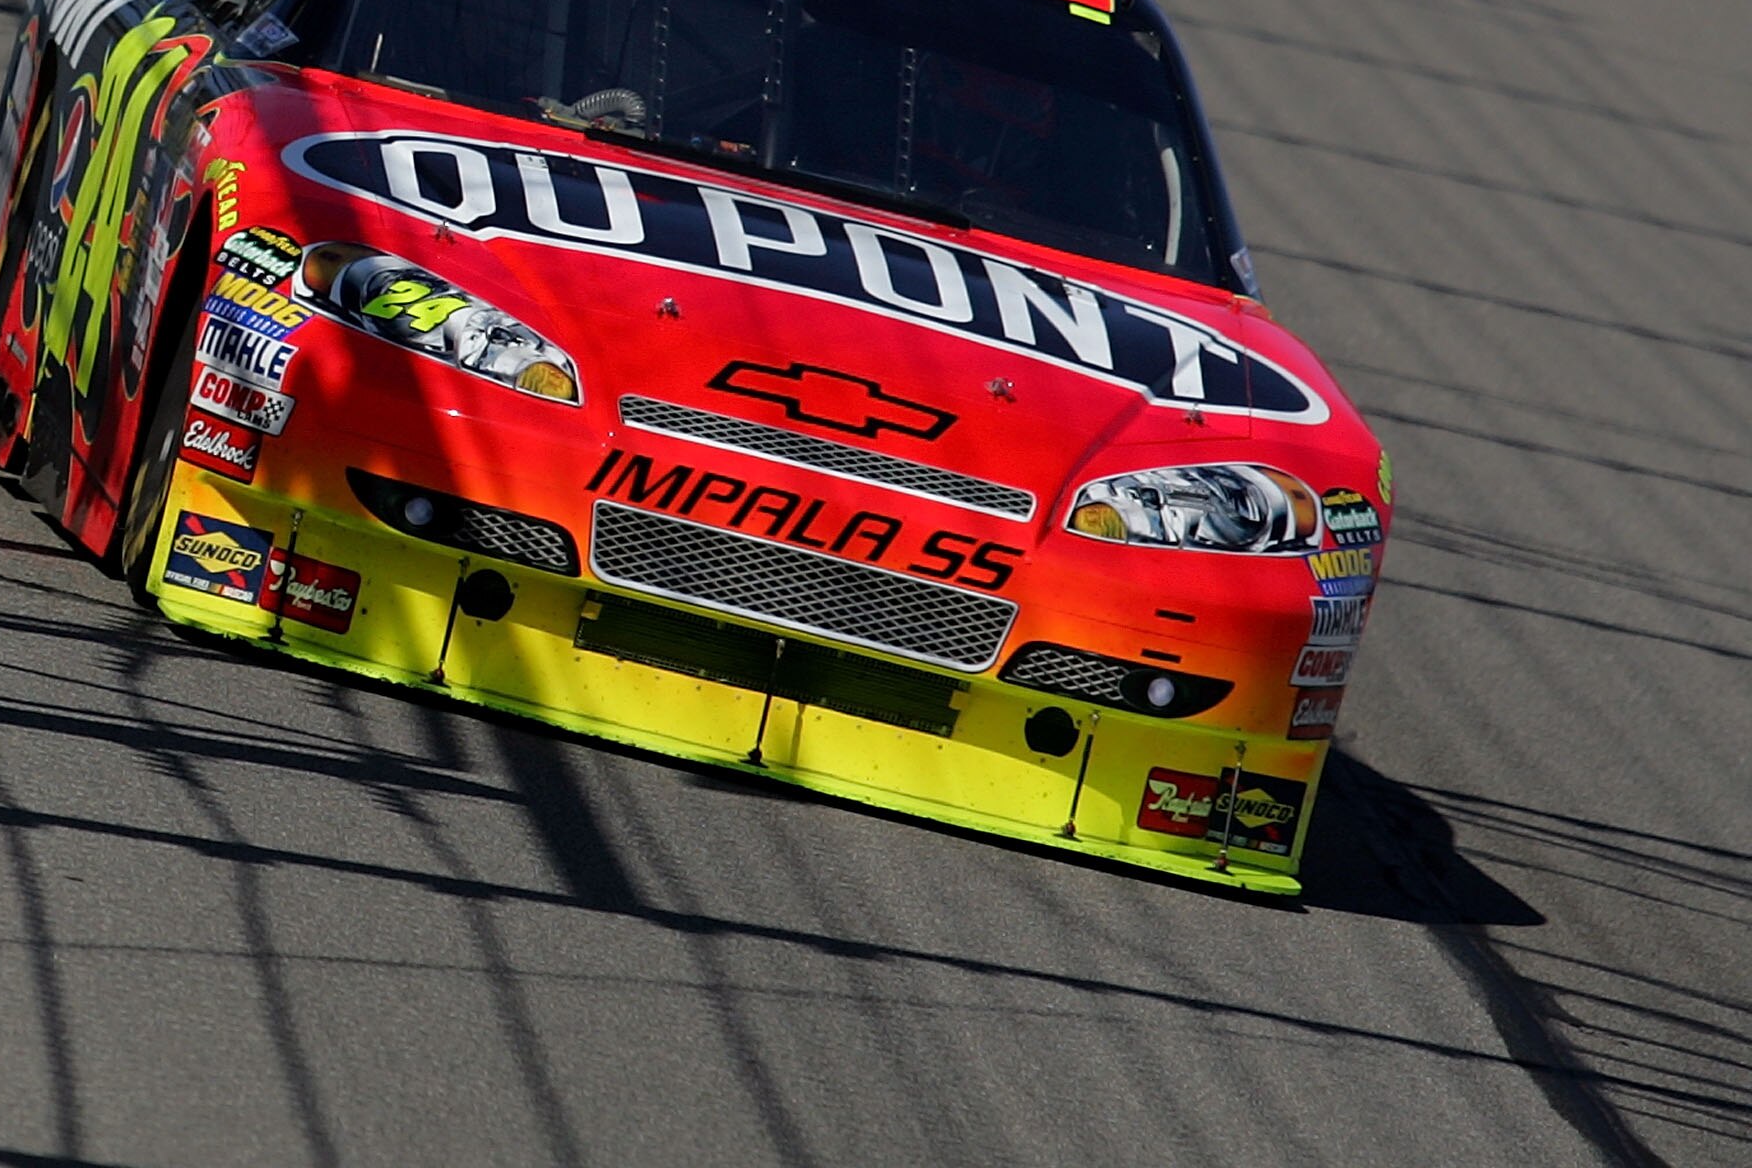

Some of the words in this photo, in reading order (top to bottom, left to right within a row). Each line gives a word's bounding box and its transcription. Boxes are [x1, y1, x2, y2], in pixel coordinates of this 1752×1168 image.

[216, 252, 277, 285] BELTS
[211, 271, 313, 328] MOOG
[361, 280, 470, 333] 24
[697, 185, 1239, 400] PONT
[198, 318, 295, 381] MAHLE
[199, 372, 266, 413] COMP
[183, 420, 257, 470] Edelbrock
[585, 448, 903, 562] IMPALA
[908, 530, 1025, 591] SS
[1336, 530, 1381, 545] BELTS
[176, 537, 258, 568] SUNOCO
[1308, 548, 1372, 581] MOOG
[1217, 794, 1291, 820] SUNOCO
